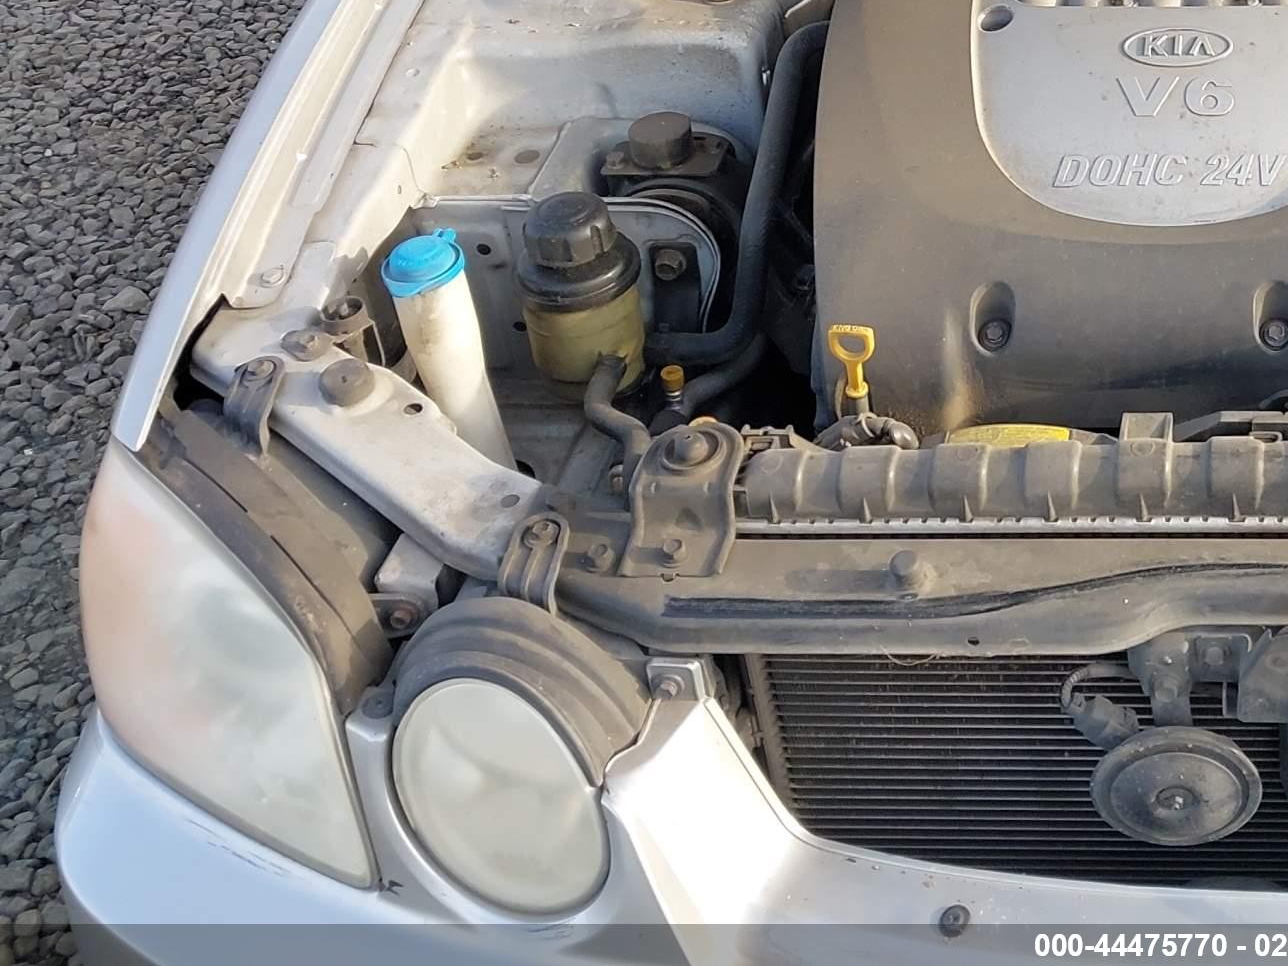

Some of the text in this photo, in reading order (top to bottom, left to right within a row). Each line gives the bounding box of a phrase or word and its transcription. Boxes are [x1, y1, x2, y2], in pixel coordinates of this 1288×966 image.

[1141, 32, 1216, 58] KIA
[1116, 76, 1236, 117] V6
[1052, 153, 1288, 188] DOHC 24V
